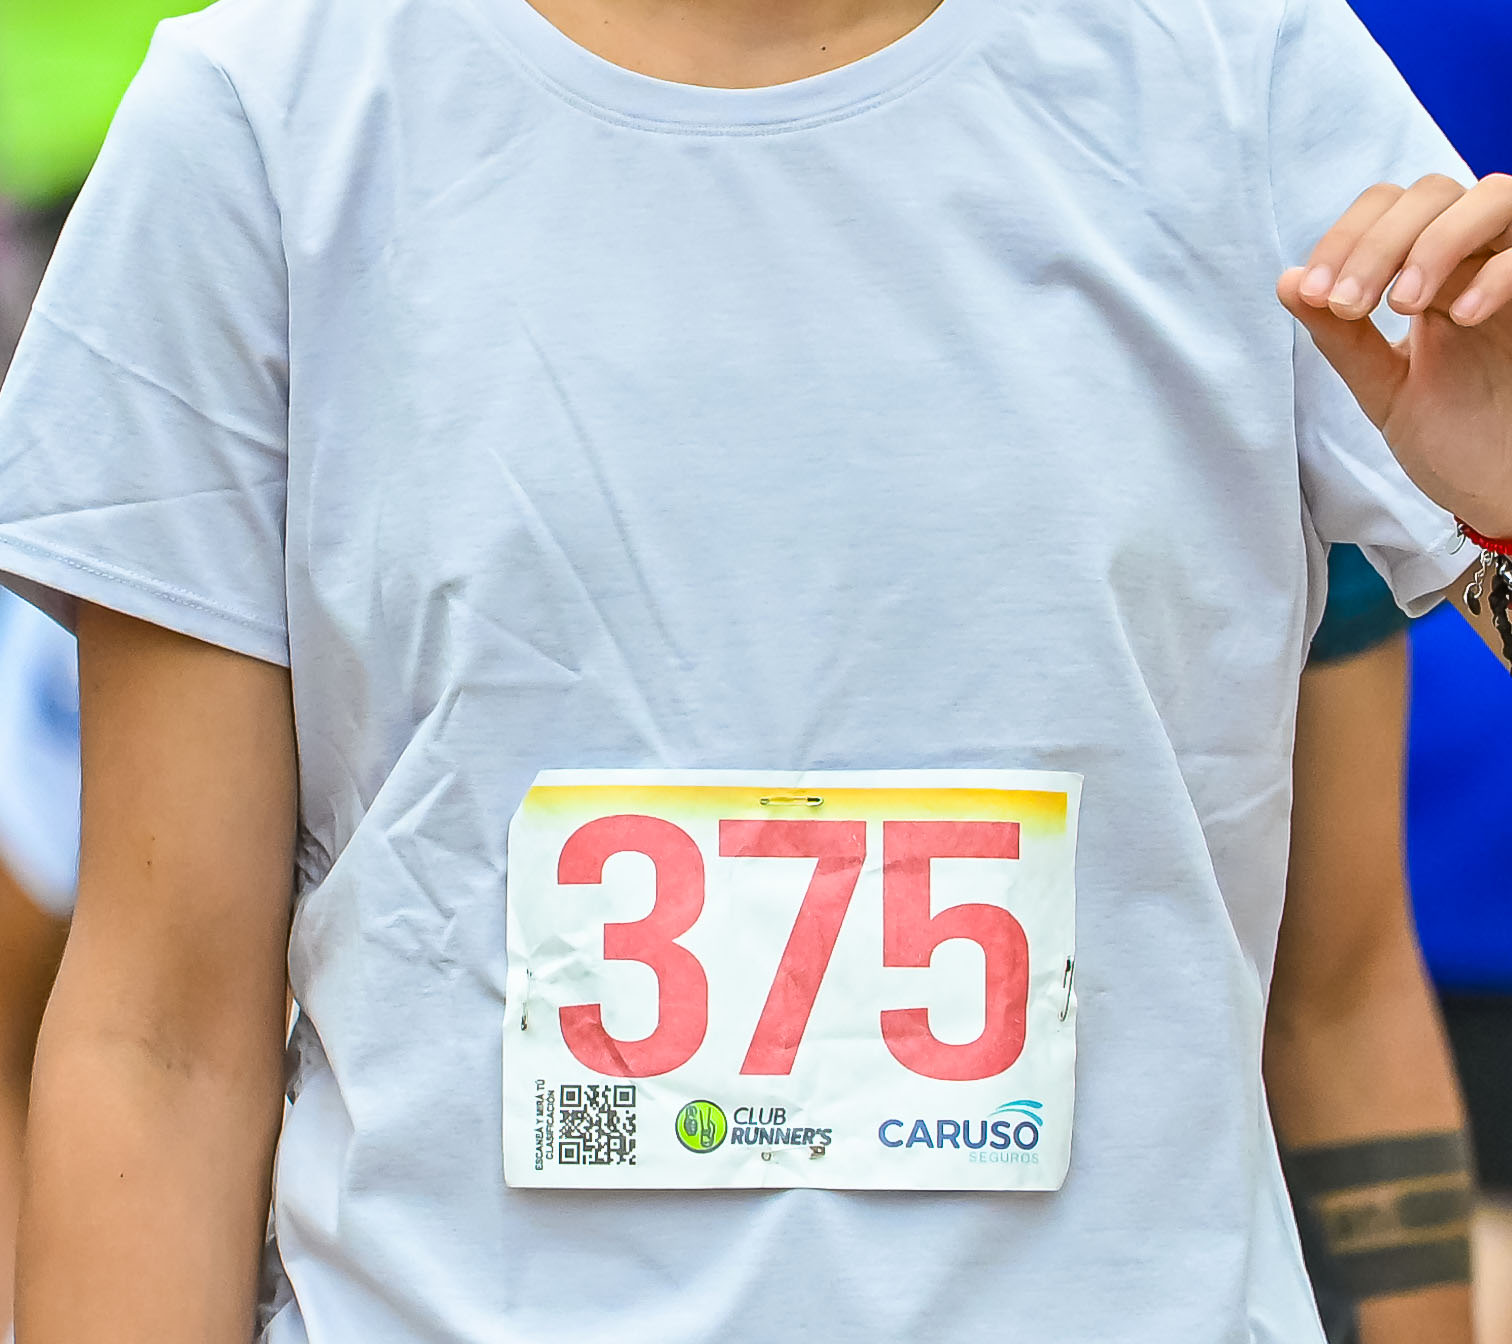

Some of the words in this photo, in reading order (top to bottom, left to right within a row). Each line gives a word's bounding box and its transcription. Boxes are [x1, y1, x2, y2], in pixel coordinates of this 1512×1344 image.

[557, 814, 1029, 1081] 375
[535, 1079, 545, 1091] TÚ
[546, 1090, 554, 1160] CLASIFICACIÓN
[734, 1107, 786, 1125] CLUB
[731, 1127, 832, 1146] RUNNER'S
[879, 1119, 1039, 1150] CARUSO
[969, 1151, 1039, 1164] SEGUROS
